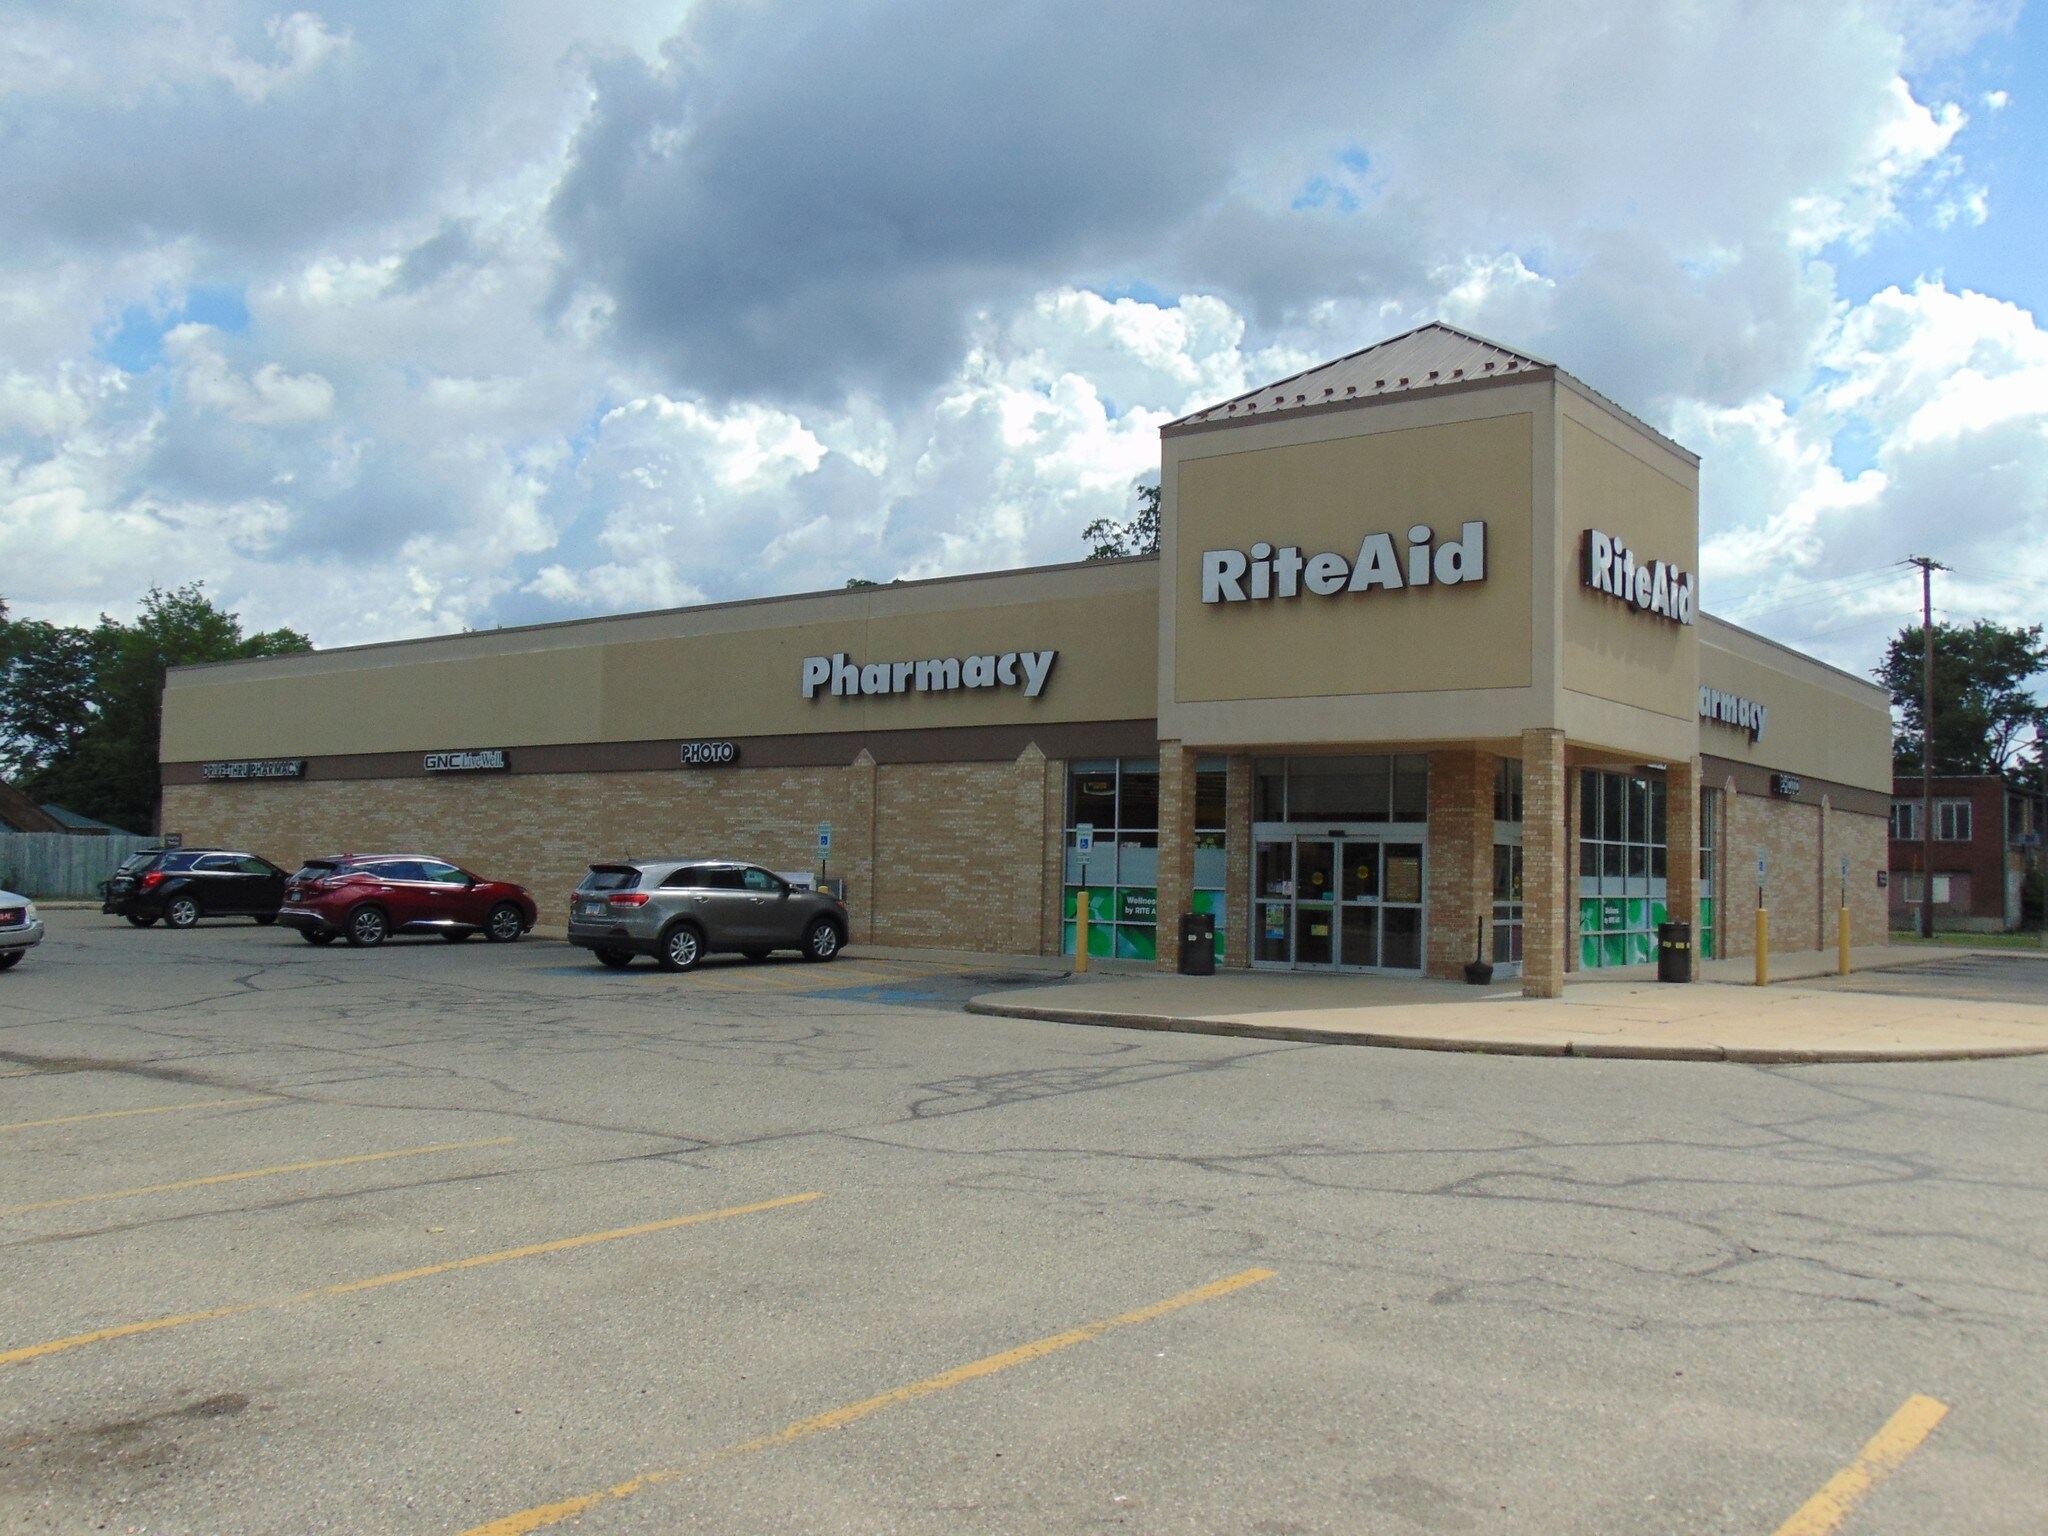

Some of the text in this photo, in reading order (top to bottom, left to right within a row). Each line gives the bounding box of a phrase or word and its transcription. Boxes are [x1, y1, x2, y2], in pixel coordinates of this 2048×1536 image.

[803, 651, 1056, 697] Pharmacy
[1700, 686, 1768, 743] armacy
[681, 742, 733, 762] PHOTO
[250, 760, 301, 776] PHARMACY
[424, 753, 460, 770] GNC
[1127, 896, 1157, 905] Wellnes
[1125, 906, 1133, 915] by
[1135, 907, 1150, 915] RITE
